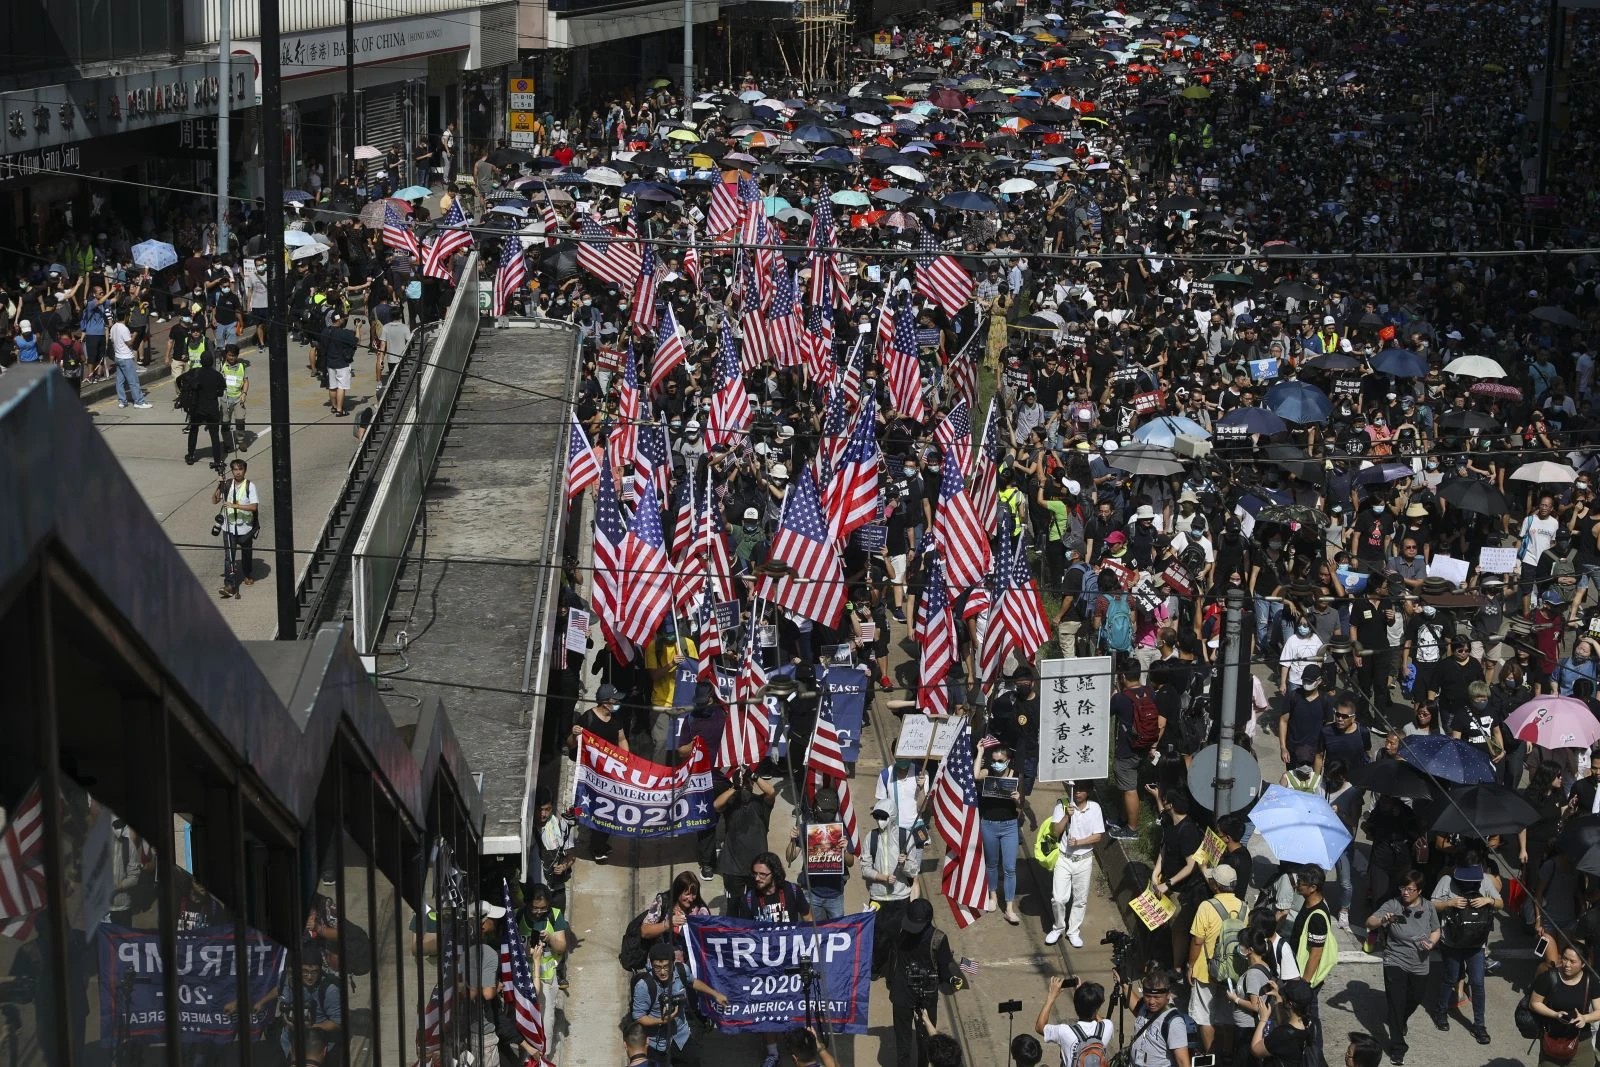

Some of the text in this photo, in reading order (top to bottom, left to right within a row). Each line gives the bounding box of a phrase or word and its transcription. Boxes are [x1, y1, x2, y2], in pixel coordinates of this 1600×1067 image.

[333, 38, 360, 57] BAK
[362, 36, 374, 51] OF
[376, 32, 406, 50] CHINA
[18, 153, 40, 176] Chow
[41, 148, 60, 172] Sang
[61, 144, 80, 169] Sang
[909, 729, 924, 738] the
[911, 718, 926, 727] We
[585, 745, 704, 789] TRUMP
[585, 770, 608, 790] KEEP
[609, 784, 670, 802] AMERICA
[591, 815, 623, 832] President
[626, 825, 637, 833] Of
[686, 818, 711, 827] States
[593, 796, 690, 827] 2020
[706, 931, 852, 968] TRUMP
[711, 1000, 740, 1016] KEEP
[742, 999, 795, 1015] AMERICA
